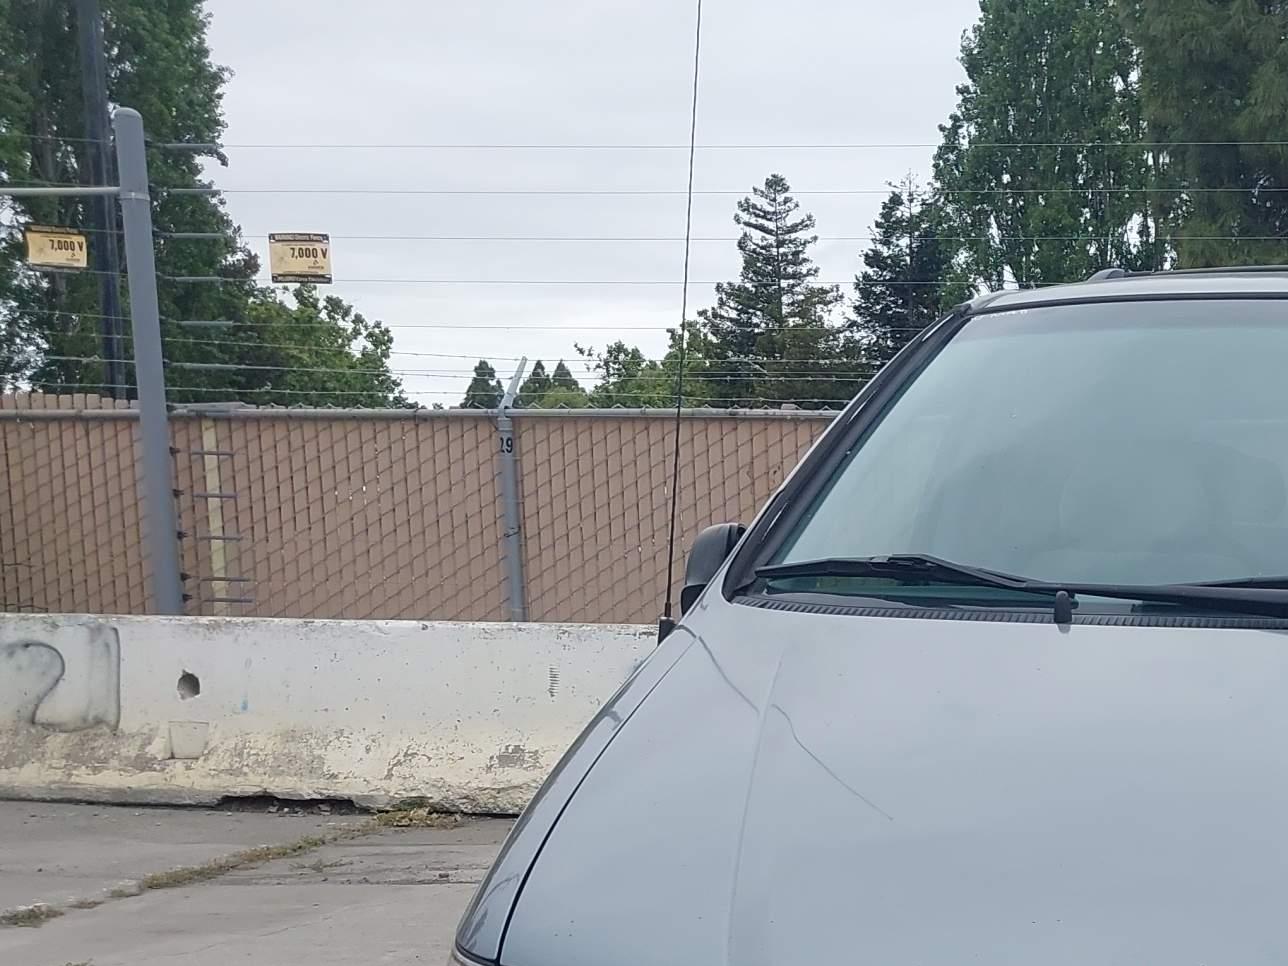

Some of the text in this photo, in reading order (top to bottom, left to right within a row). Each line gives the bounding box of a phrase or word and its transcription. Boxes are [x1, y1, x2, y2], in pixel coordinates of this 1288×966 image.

[48, 239, 84, 252] 7,000 V
[289, 247, 328, 260] 7,000 V
